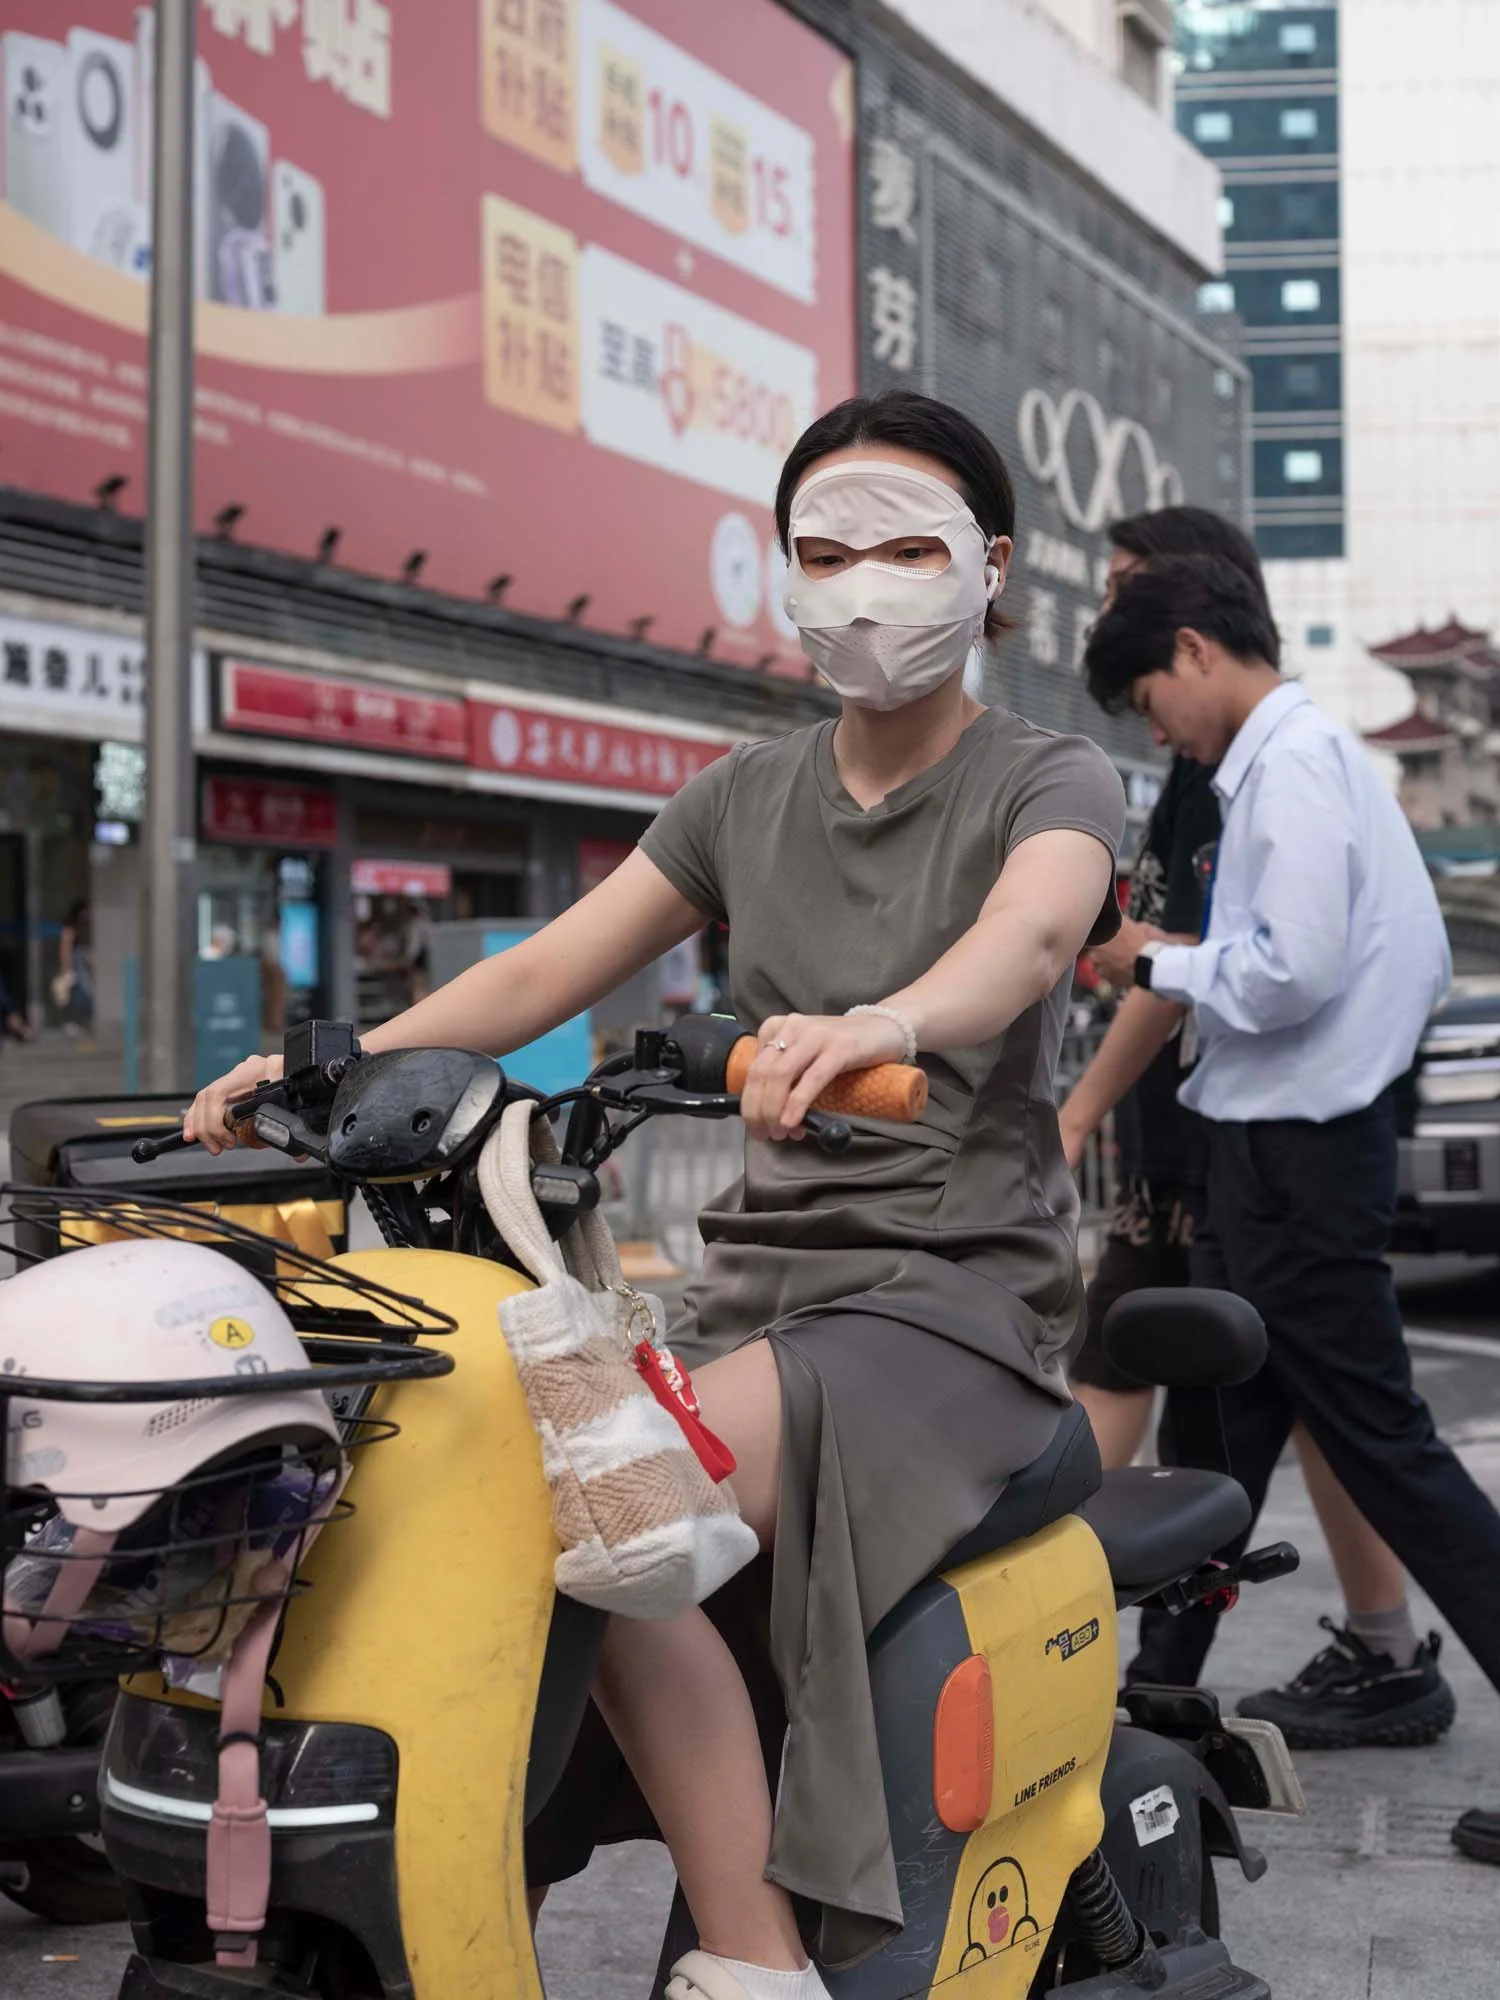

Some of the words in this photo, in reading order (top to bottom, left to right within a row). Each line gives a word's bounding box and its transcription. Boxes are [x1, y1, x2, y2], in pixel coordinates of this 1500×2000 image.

[226, 1322, 245, 1343] A
[1014, 1782, 1037, 1807] LINE
[1038, 1756, 1076, 1793] FRIENDS
